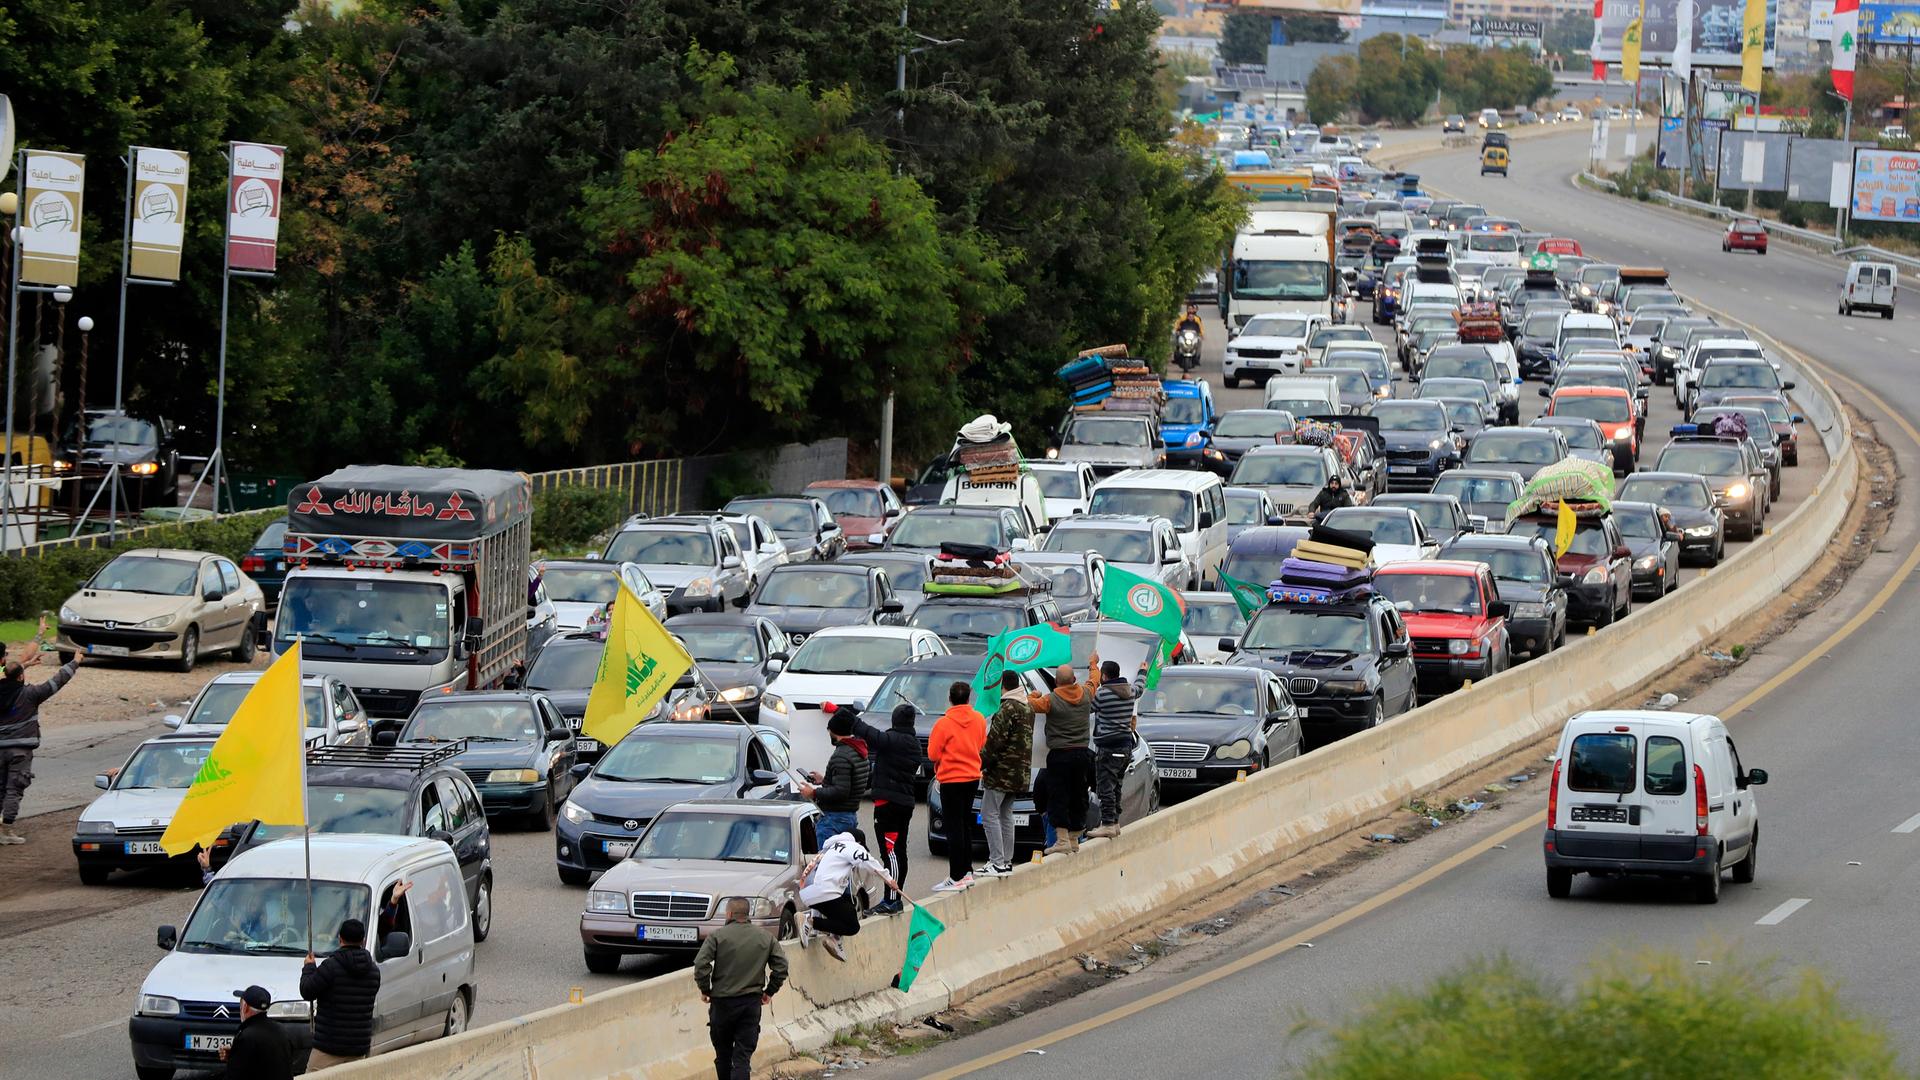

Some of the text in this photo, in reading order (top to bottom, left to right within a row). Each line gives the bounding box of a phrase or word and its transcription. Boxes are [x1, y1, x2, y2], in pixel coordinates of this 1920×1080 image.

[333, 488, 371, 514] الله
[1163, 768, 1192, 778] 678282
[193, 1036, 201, 1048] M
